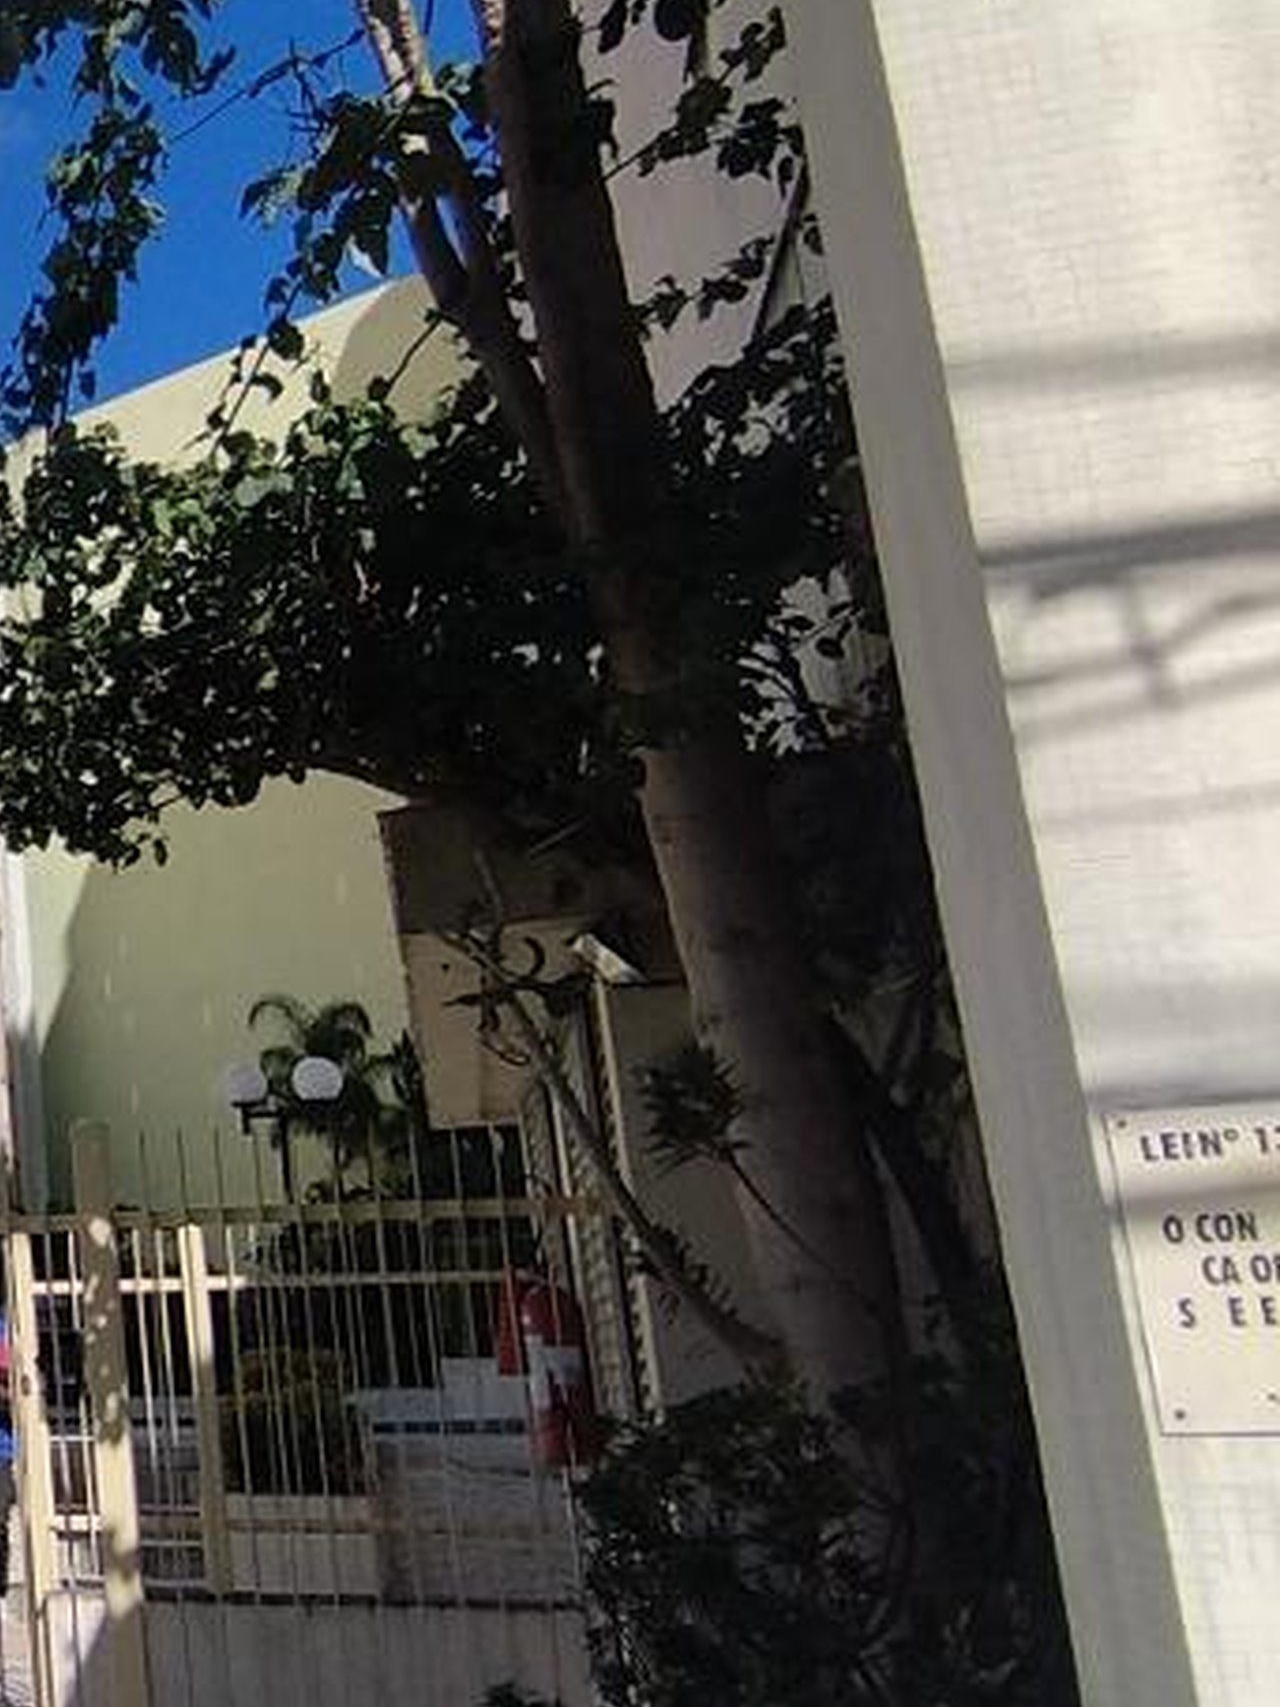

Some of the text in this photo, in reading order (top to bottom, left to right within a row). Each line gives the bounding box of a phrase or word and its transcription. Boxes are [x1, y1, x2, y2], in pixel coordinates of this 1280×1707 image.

[1162, 1211, 1258, 1244] O CON
[1201, 1254, 1242, 1286] CA
